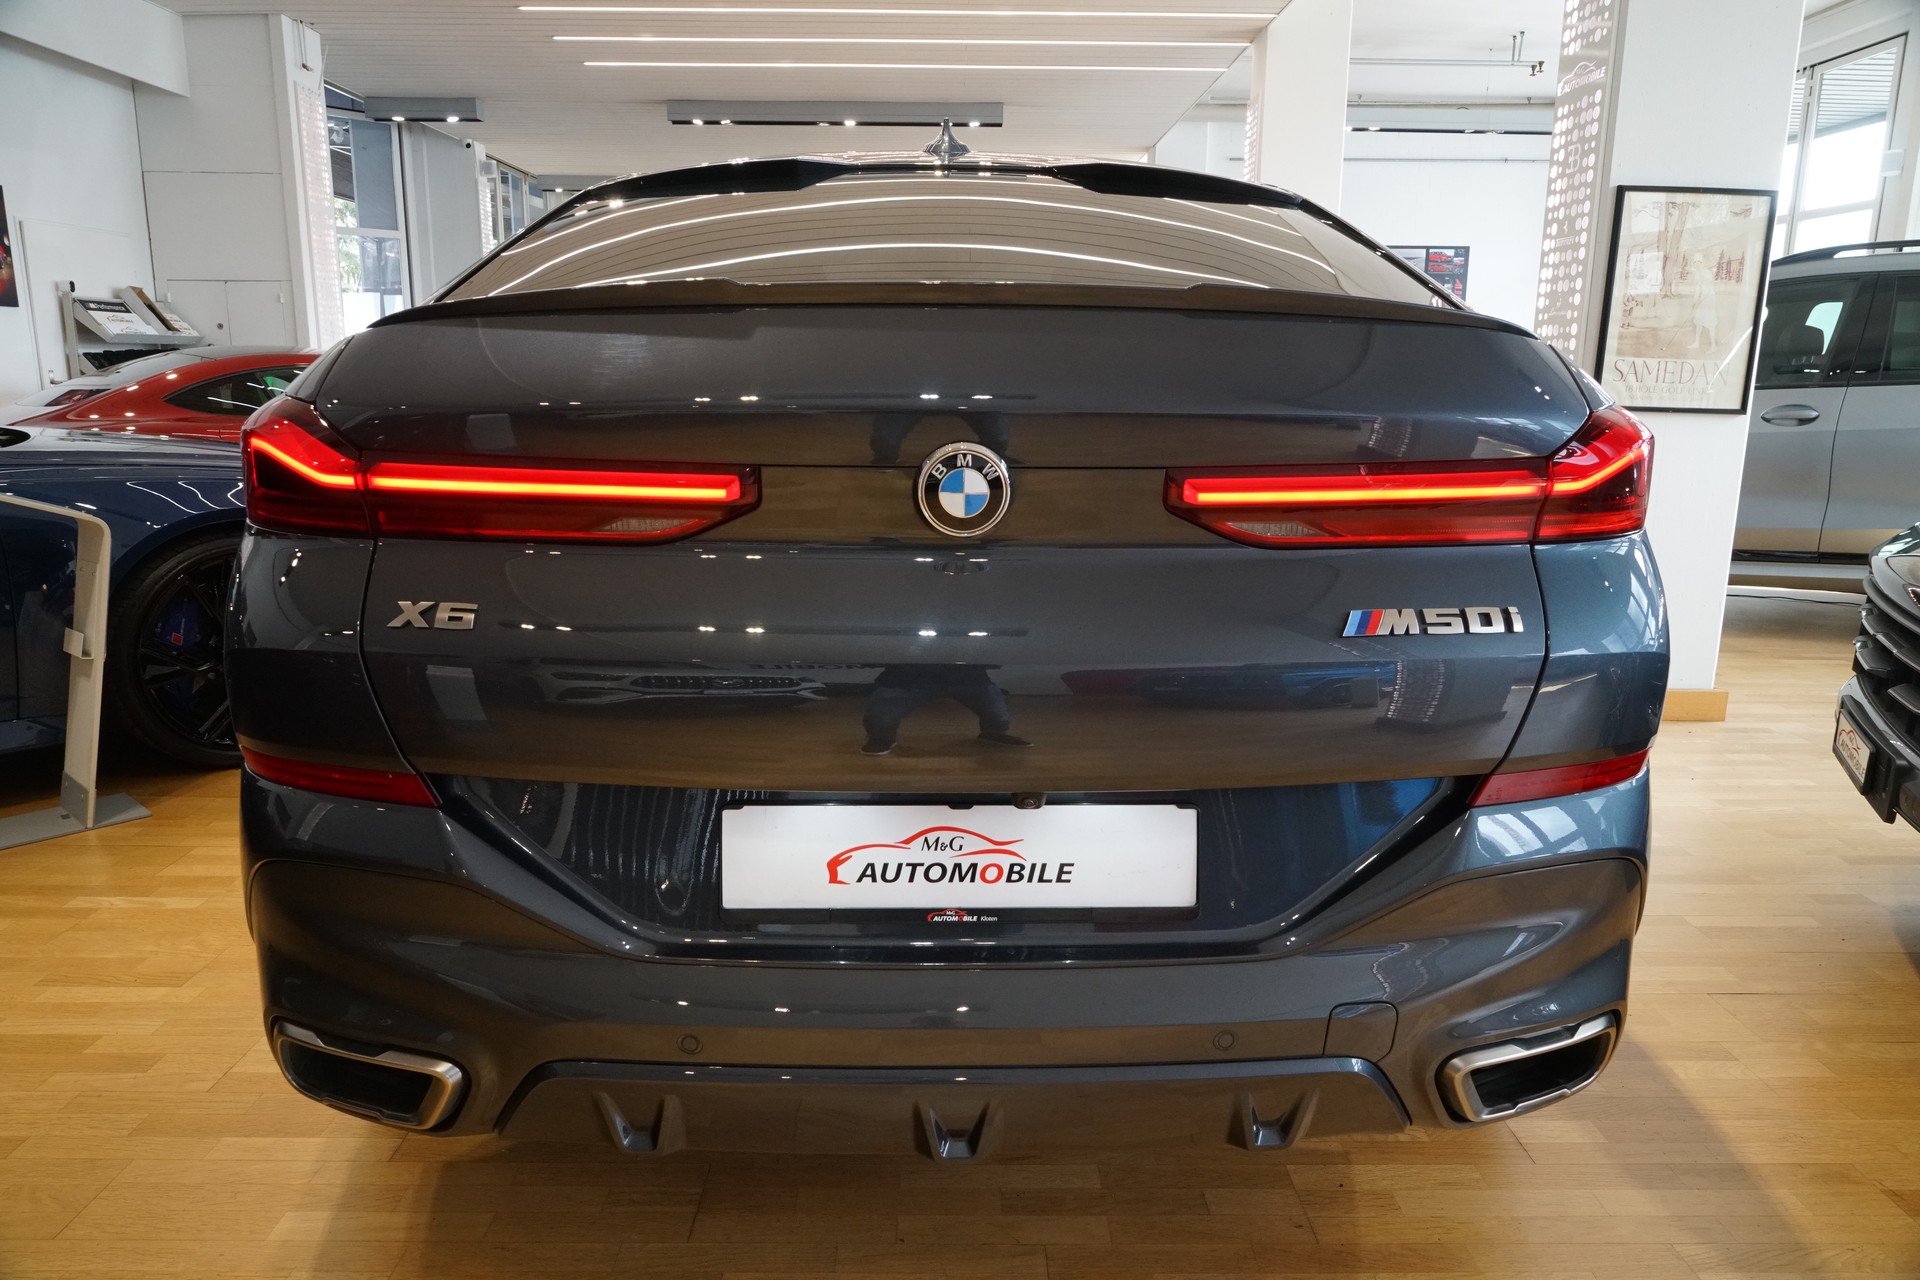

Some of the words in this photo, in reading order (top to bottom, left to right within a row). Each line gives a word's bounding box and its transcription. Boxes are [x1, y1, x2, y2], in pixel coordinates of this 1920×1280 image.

[1612, 358, 1730, 386] SAMEDAN
[1636, 385, 1658, 394] HOLE
[930, 453, 999, 481] BMW
[386, 600, 478, 630] X6
[1376, 606, 1525, 635] M50i
[920, 835, 965, 853] M&G
[855, 861, 1075, 884] AUTOMOBILE
